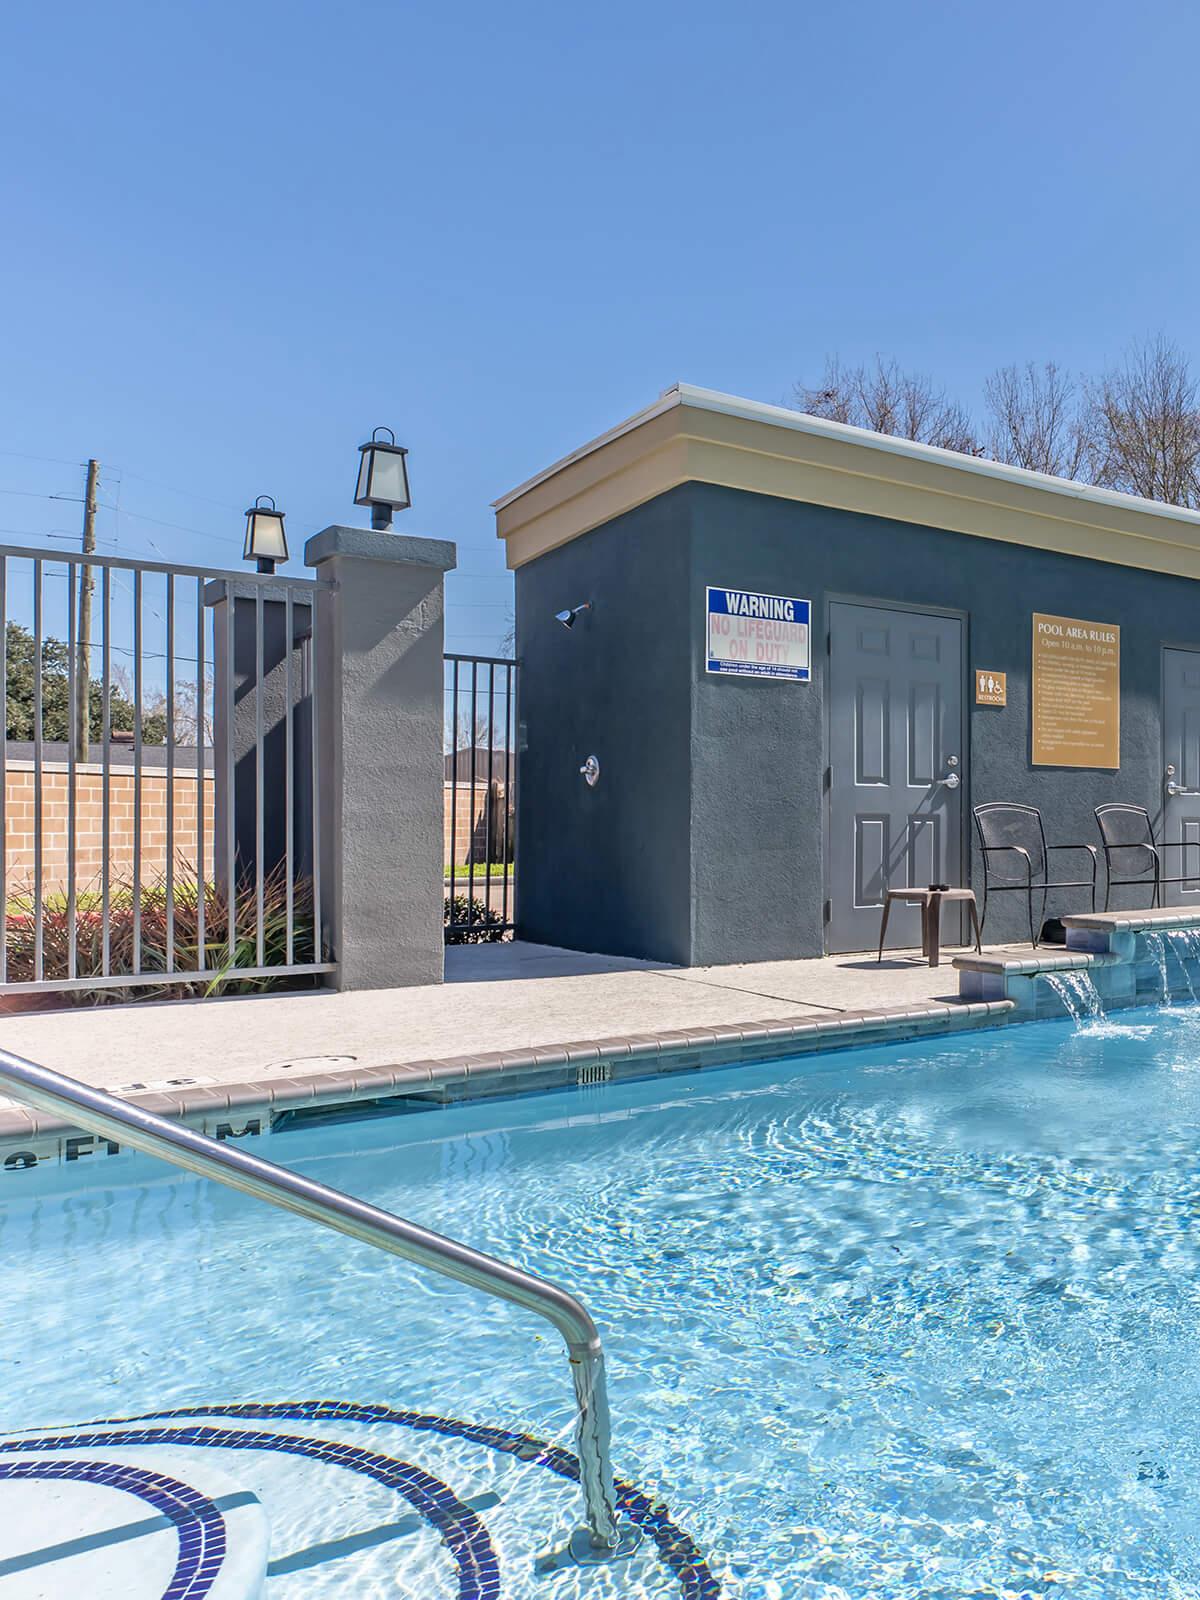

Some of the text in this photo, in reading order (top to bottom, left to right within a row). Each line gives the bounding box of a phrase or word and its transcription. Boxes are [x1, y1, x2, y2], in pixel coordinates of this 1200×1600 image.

[725, 592, 794, 621] WARNING
[711, 615, 806, 644] NO LIFEGUARD
[1038, 623, 1116, 643] POOL AREA RULES
[729, 639, 790, 663] ON DUTY
[1041, 638, 1060, 649] Open
[1061, 640, 1070, 649] 10
